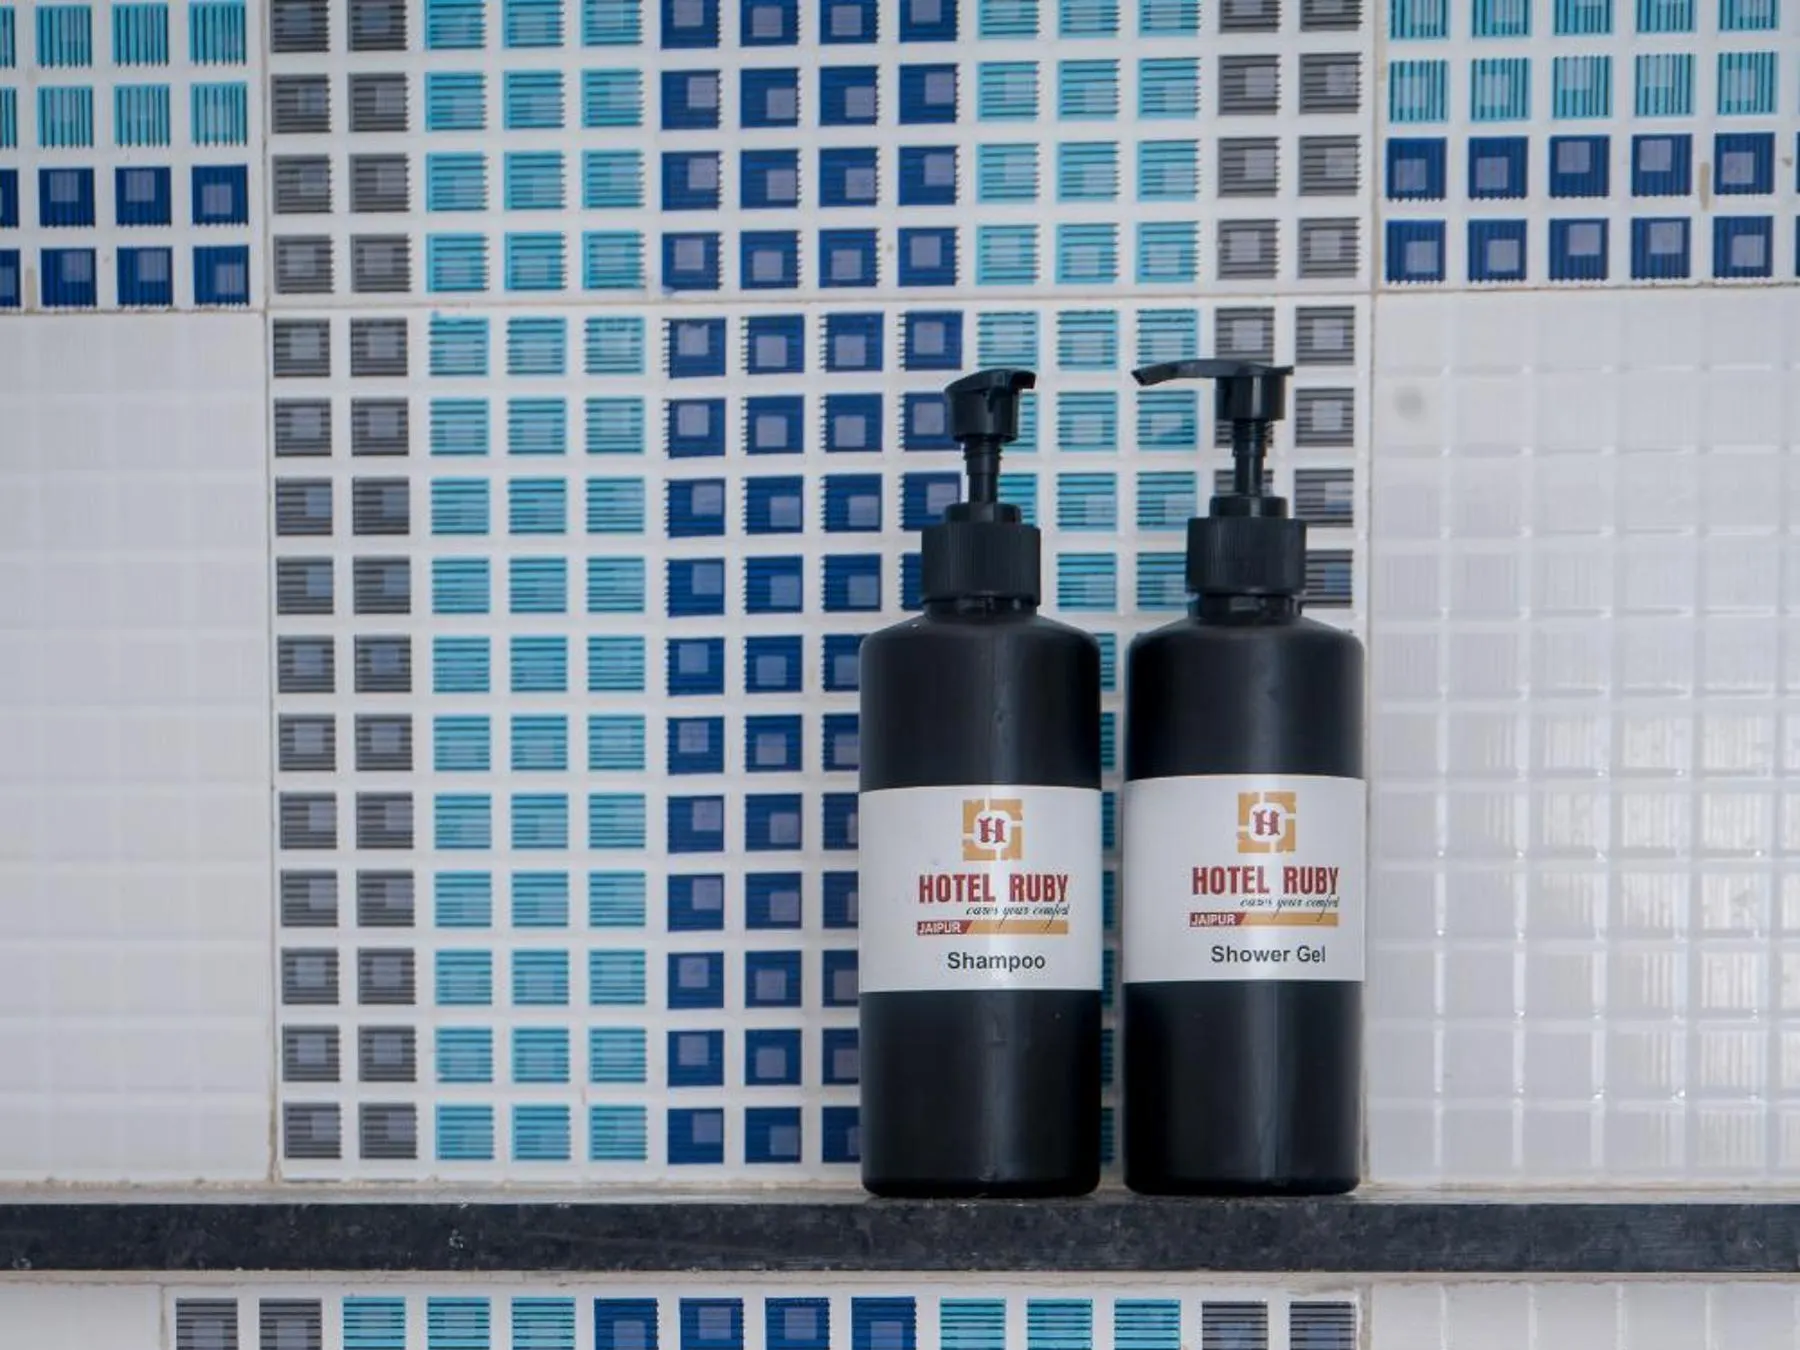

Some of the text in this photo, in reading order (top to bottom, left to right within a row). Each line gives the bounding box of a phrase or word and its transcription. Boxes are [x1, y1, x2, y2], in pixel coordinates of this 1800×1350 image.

[919, 873, 1069, 903] HOTEL RUBY
[1192, 866, 1340, 895] HOTEL RUBY
[918, 920, 962, 935] JAIPUR
[998, 905, 1030, 930] your
[1191, 913, 1237, 926] JAIPUR
[947, 951, 1047, 973] Shampoo
[1211, 944, 1327, 964] Shower Gel
